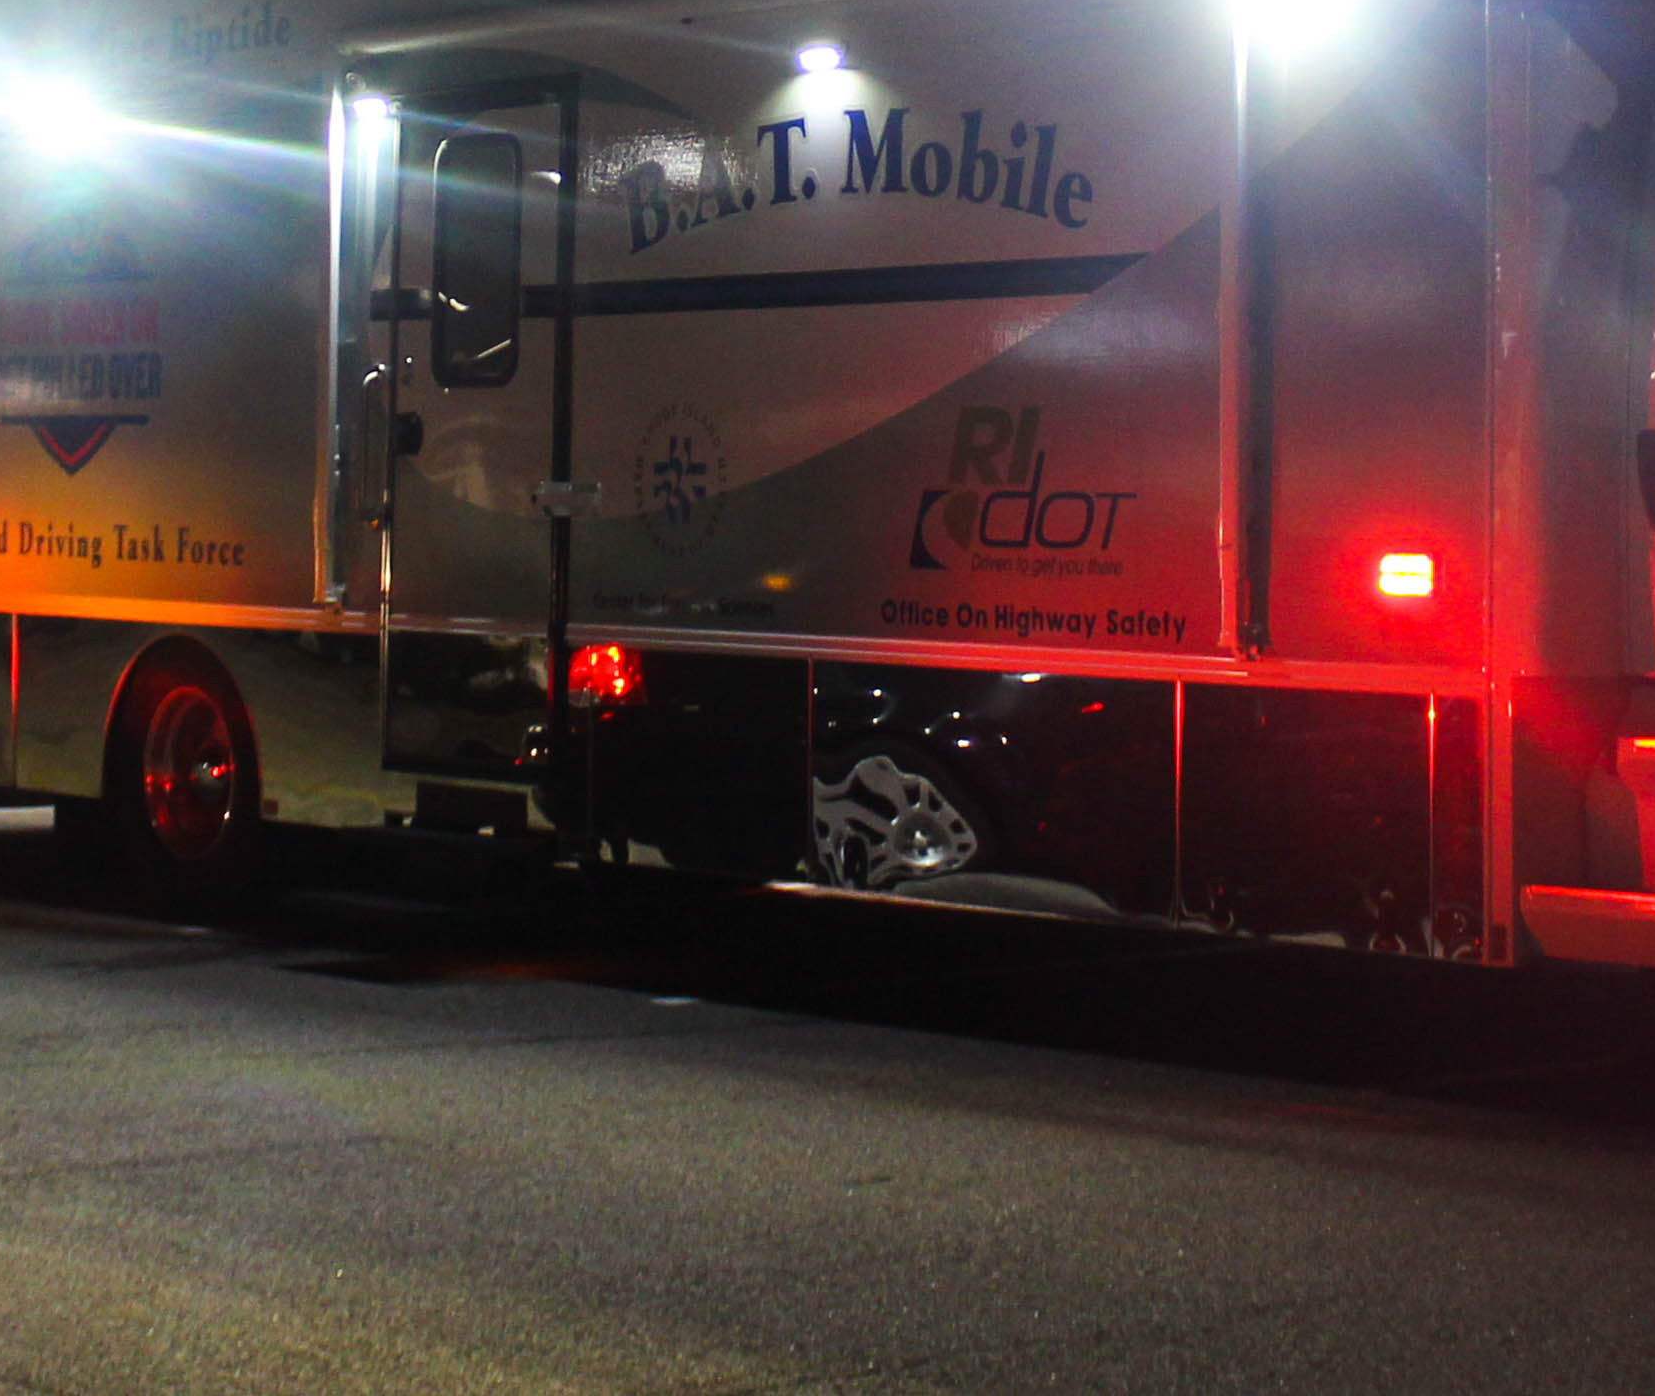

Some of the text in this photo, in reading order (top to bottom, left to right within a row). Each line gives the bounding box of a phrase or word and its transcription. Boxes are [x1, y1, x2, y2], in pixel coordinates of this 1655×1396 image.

[169, 0, 292, 65] Riptide
[620, 107, 1093, 255] B.A.T. Mobile
[948, 405, 1041, 485] RI
[18, 520, 103, 569] Driving
[114, 524, 166, 562] Task
[177, 526, 245, 566] Force
[880, 598, 1188, 644] Office On Highway Safety
